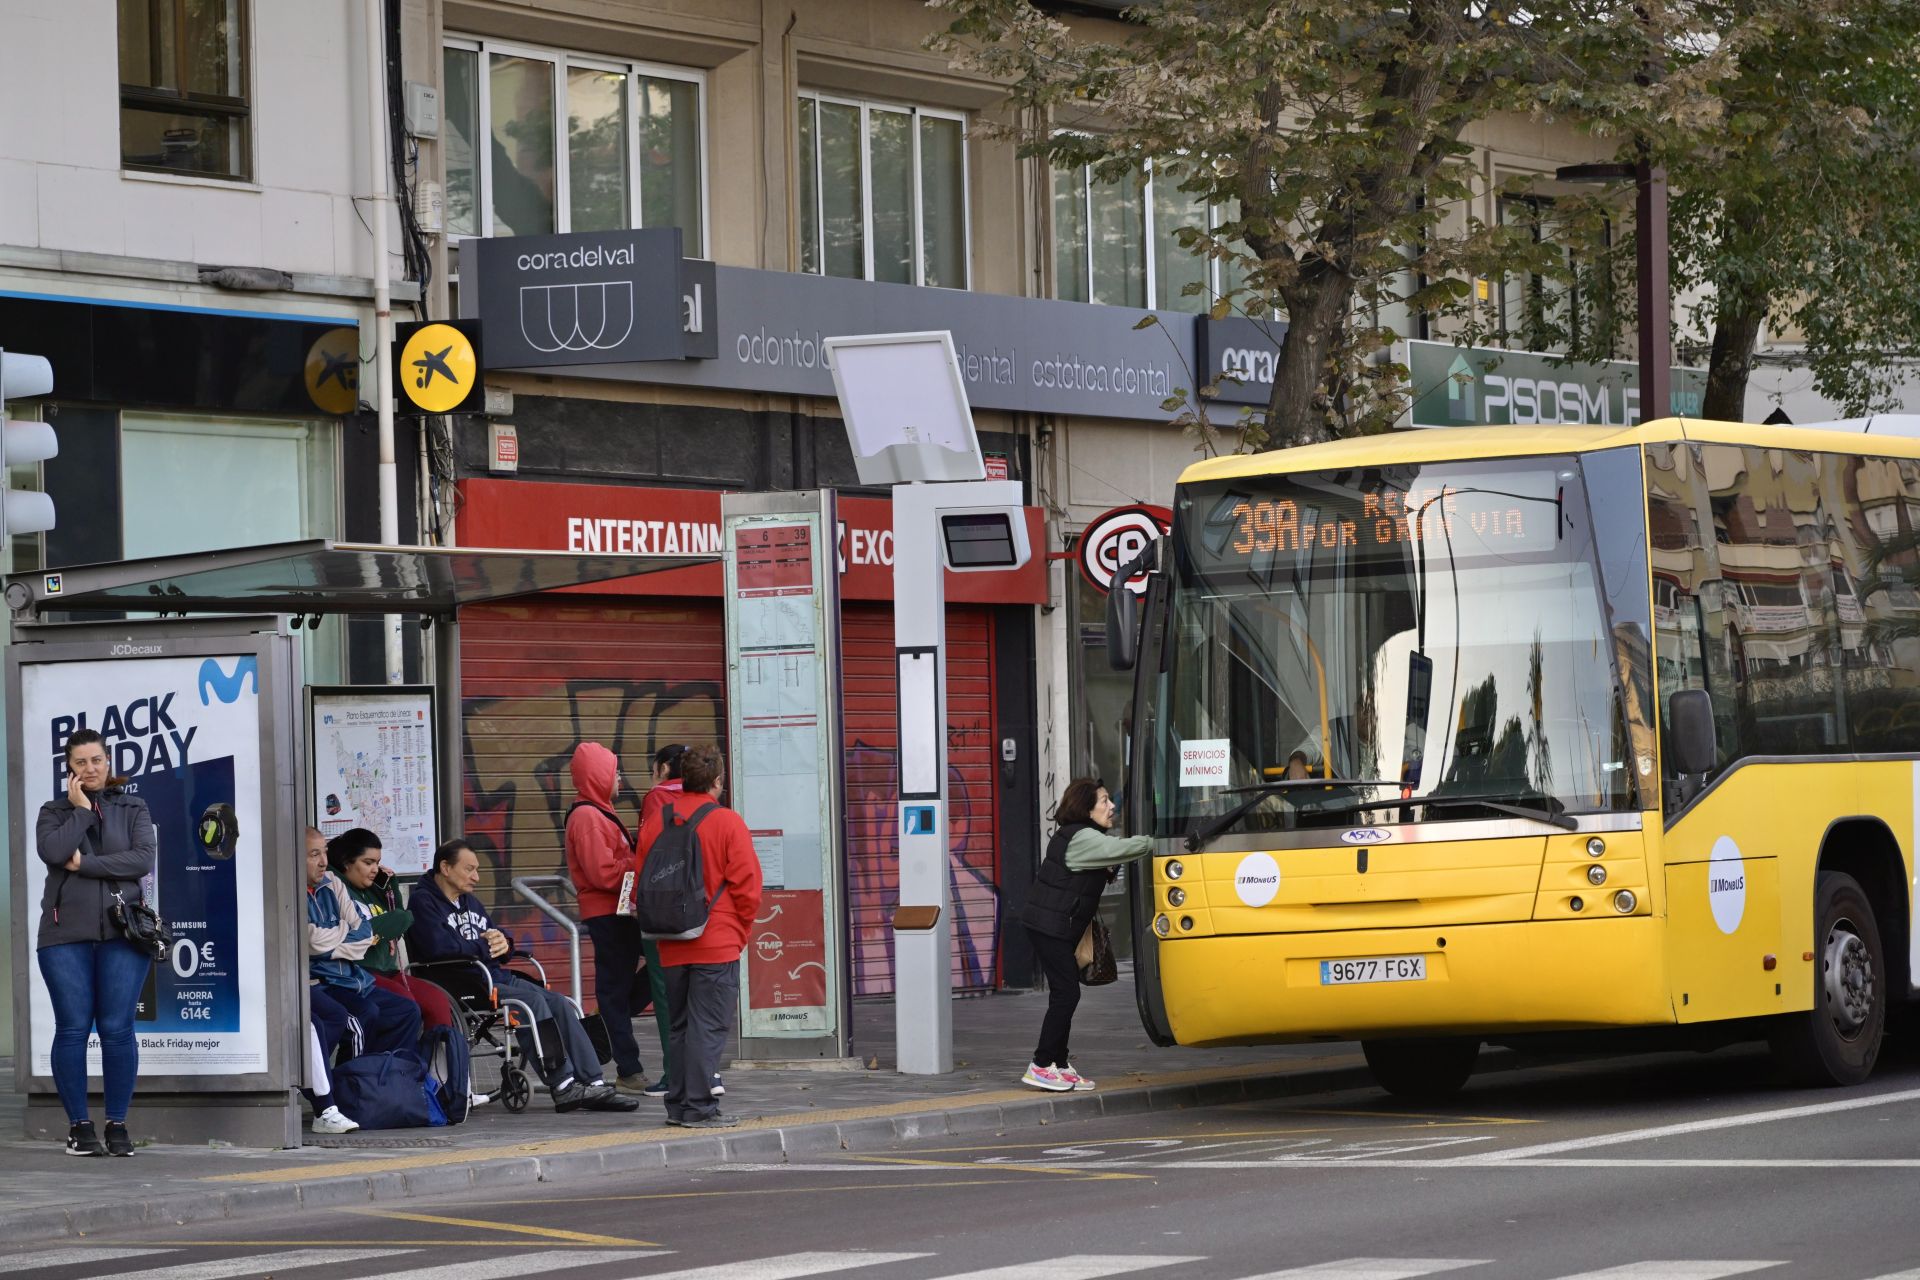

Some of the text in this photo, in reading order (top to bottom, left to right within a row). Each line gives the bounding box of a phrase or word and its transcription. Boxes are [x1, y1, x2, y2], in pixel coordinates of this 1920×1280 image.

[1032, 351, 1171, 397] estética dental
[1231, 500, 1299, 554] 39A
[1303, 521, 1358, 549] POR
[1471, 507, 1523, 536] VIA
[762, 530, 769, 542] 6
[794, 528, 806, 540] 39
[110, 644, 162, 655] JCDecaux
[1183, 749, 1226, 760] SERVICIOS
[1185, 764, 1223, 776] MÍNIMOS
[171, 921, 207, 929] SAMSUNG
[756, 941, 783, 951] TMP
[1333, 957, 1420, 981] 9677 FGX
[176, 991, 214, 1000] AHORRA
[180, 1007, 211, 1020] 614€
[141, 1038, 220, 1051] Black Friday mejor
